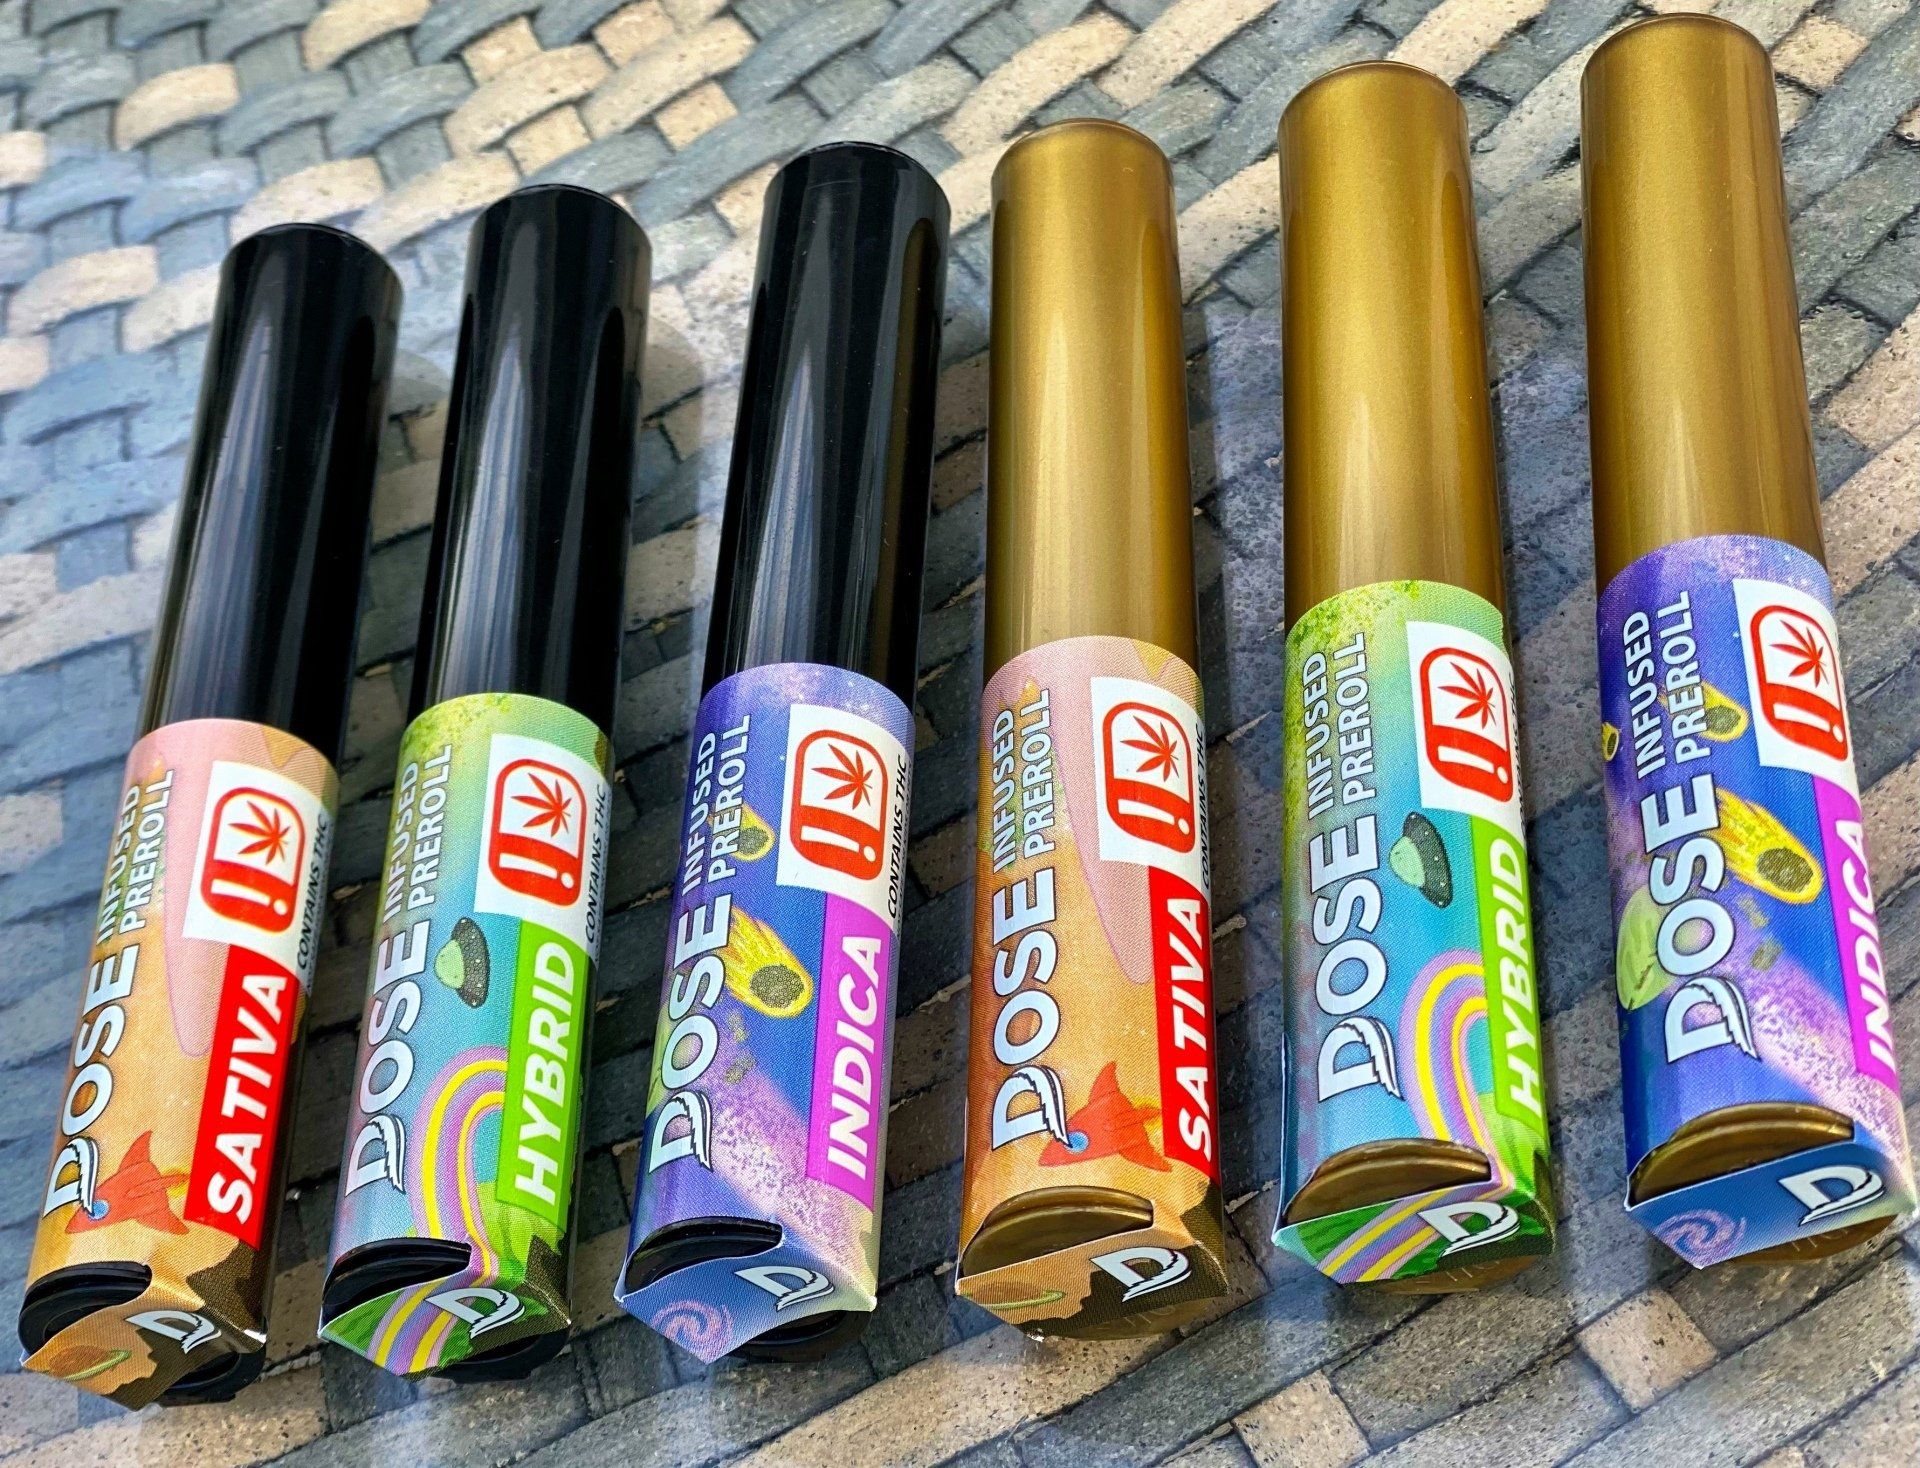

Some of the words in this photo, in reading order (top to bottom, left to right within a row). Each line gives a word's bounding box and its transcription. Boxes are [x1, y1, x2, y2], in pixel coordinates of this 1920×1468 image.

[1302, 652, 1334, 820] INFUSED
[1333, 632, 1376, 804] PREROLL
[1623, 611, 1666, 779] INFUSED
[1657, 590, 1711, 764] PREROLL
[119, 769, 174, 934] PREROLL
[385, 762, 420, 931] INFUSED
[407, 745, 453, 907] PREROLL
[682, 732, 716, 896] INFUSED
[708, 715, 750, 883] PREROLL
[888, 805, 903, 918] CONTAINS
[896, 754, 906, 800] THC
[993, 709, 1016, 873] INFUSED
[1020, 689, 1054, 858] PREROLL
[96, 785, 140, 945] INFUSED
[297, 862, 319, 969] CONTAINS
[313, 813, 327, 857] THC
[586, 833, 601, 943] CONTAINS
[595, 784, 606, 829] THC
[1642, 774, 1759, 1064] DOSE
[1835, 819, 1896, 1074] INDICA
[648, 894, 731, 1173] DOSE
[992, 867, 1072, 1150] DOSE
[1167, 899, 1211, 1161] SATIVA
[1309, 815, 1404, 1102] DOSE
[1490, 838, 1541, 1118] HYBRID
[43, 945, 138, 1217] DOSE
[208, 975, 286, 1223] SATIVA
[344, 919, 429, 1195] DOSE
[514, 943, 575, 1206] HYBRID
[828, 937, 883, 1179] INDICA
